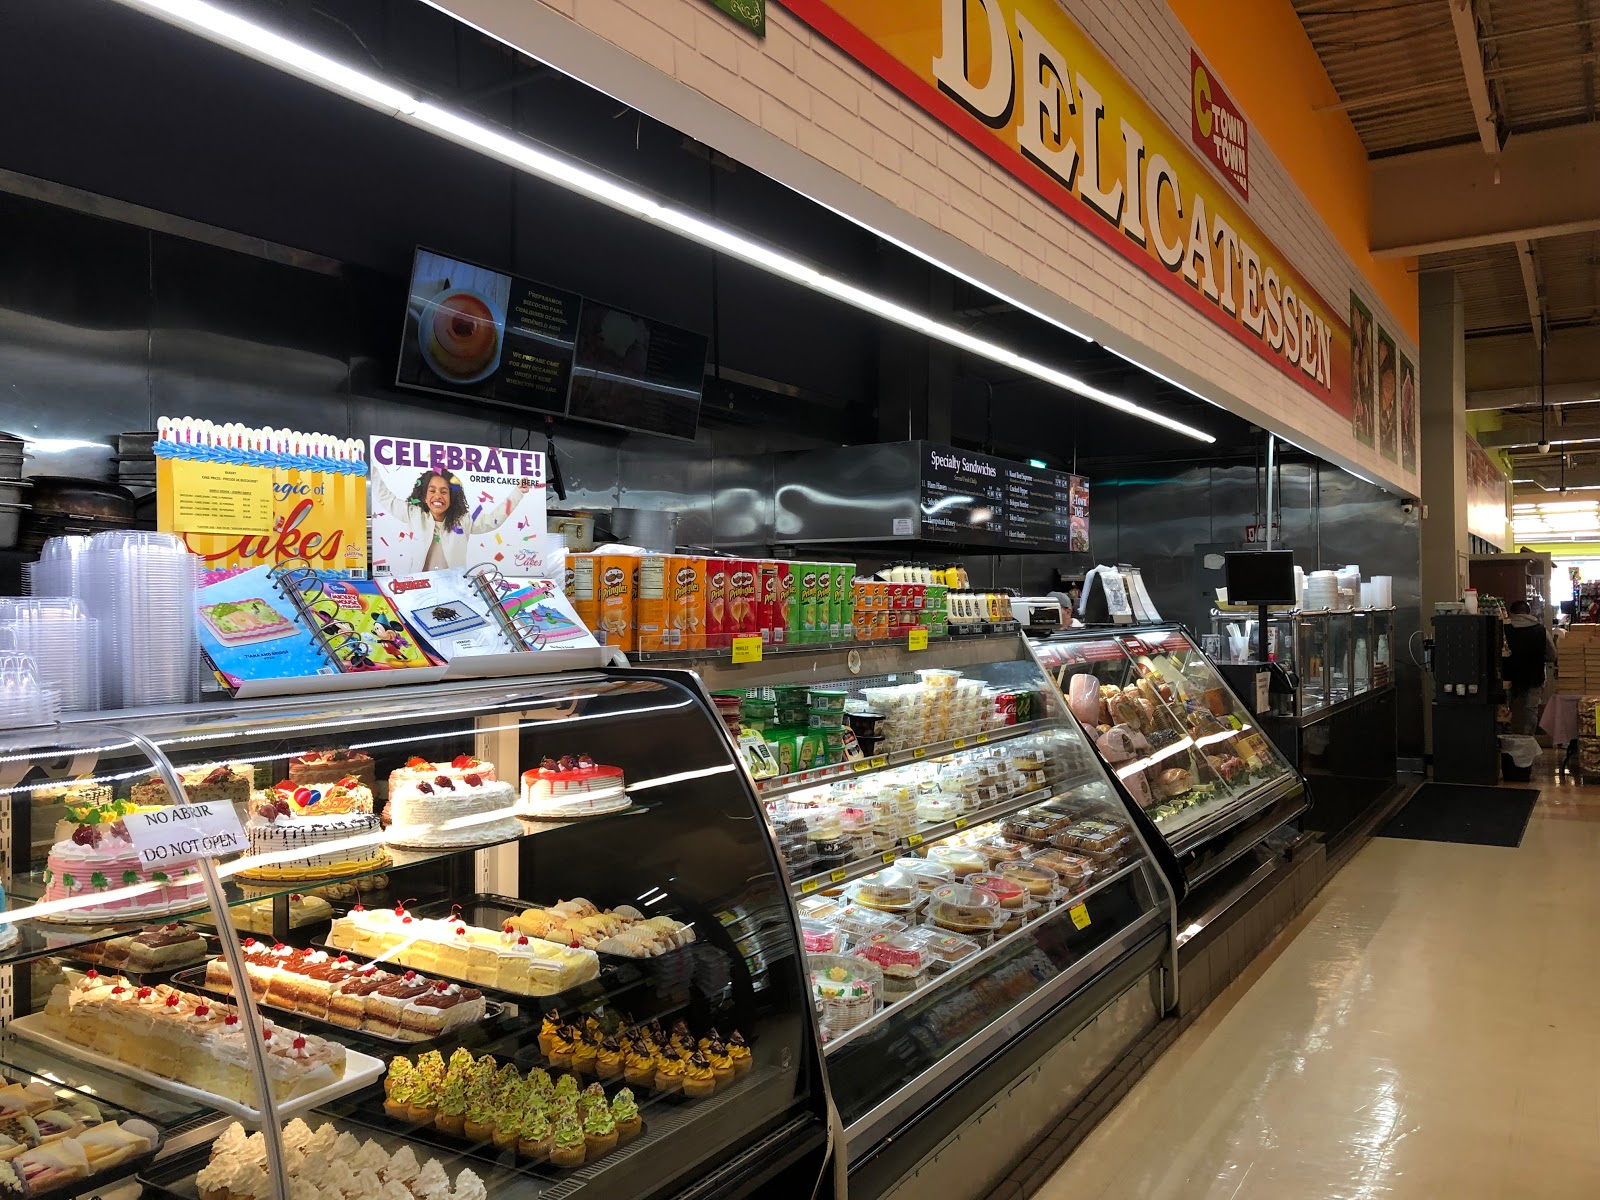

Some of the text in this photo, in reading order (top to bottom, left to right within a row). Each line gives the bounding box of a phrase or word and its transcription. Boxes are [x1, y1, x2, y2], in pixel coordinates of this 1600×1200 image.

[1212, 103, 1245, 147] TOWN
[1213, 134, 1246, 175] TOWN
[932, 0, 1332, 389] DELICATESSEN
[374, 438, 541, 478] CELEBRATE!
[931, 450, 997, 478] Specialty Sandwiches
[273, 482, 324, 502] agic of
[470, 475, 495, 484] ORDER
[496, 477, 520, 486] CAKES
[601, 584, 628, 601] Pringles
[144, 804, 214, 826] NO ABRIR
[143, 832, 238, 862] DO NOT OPEN
